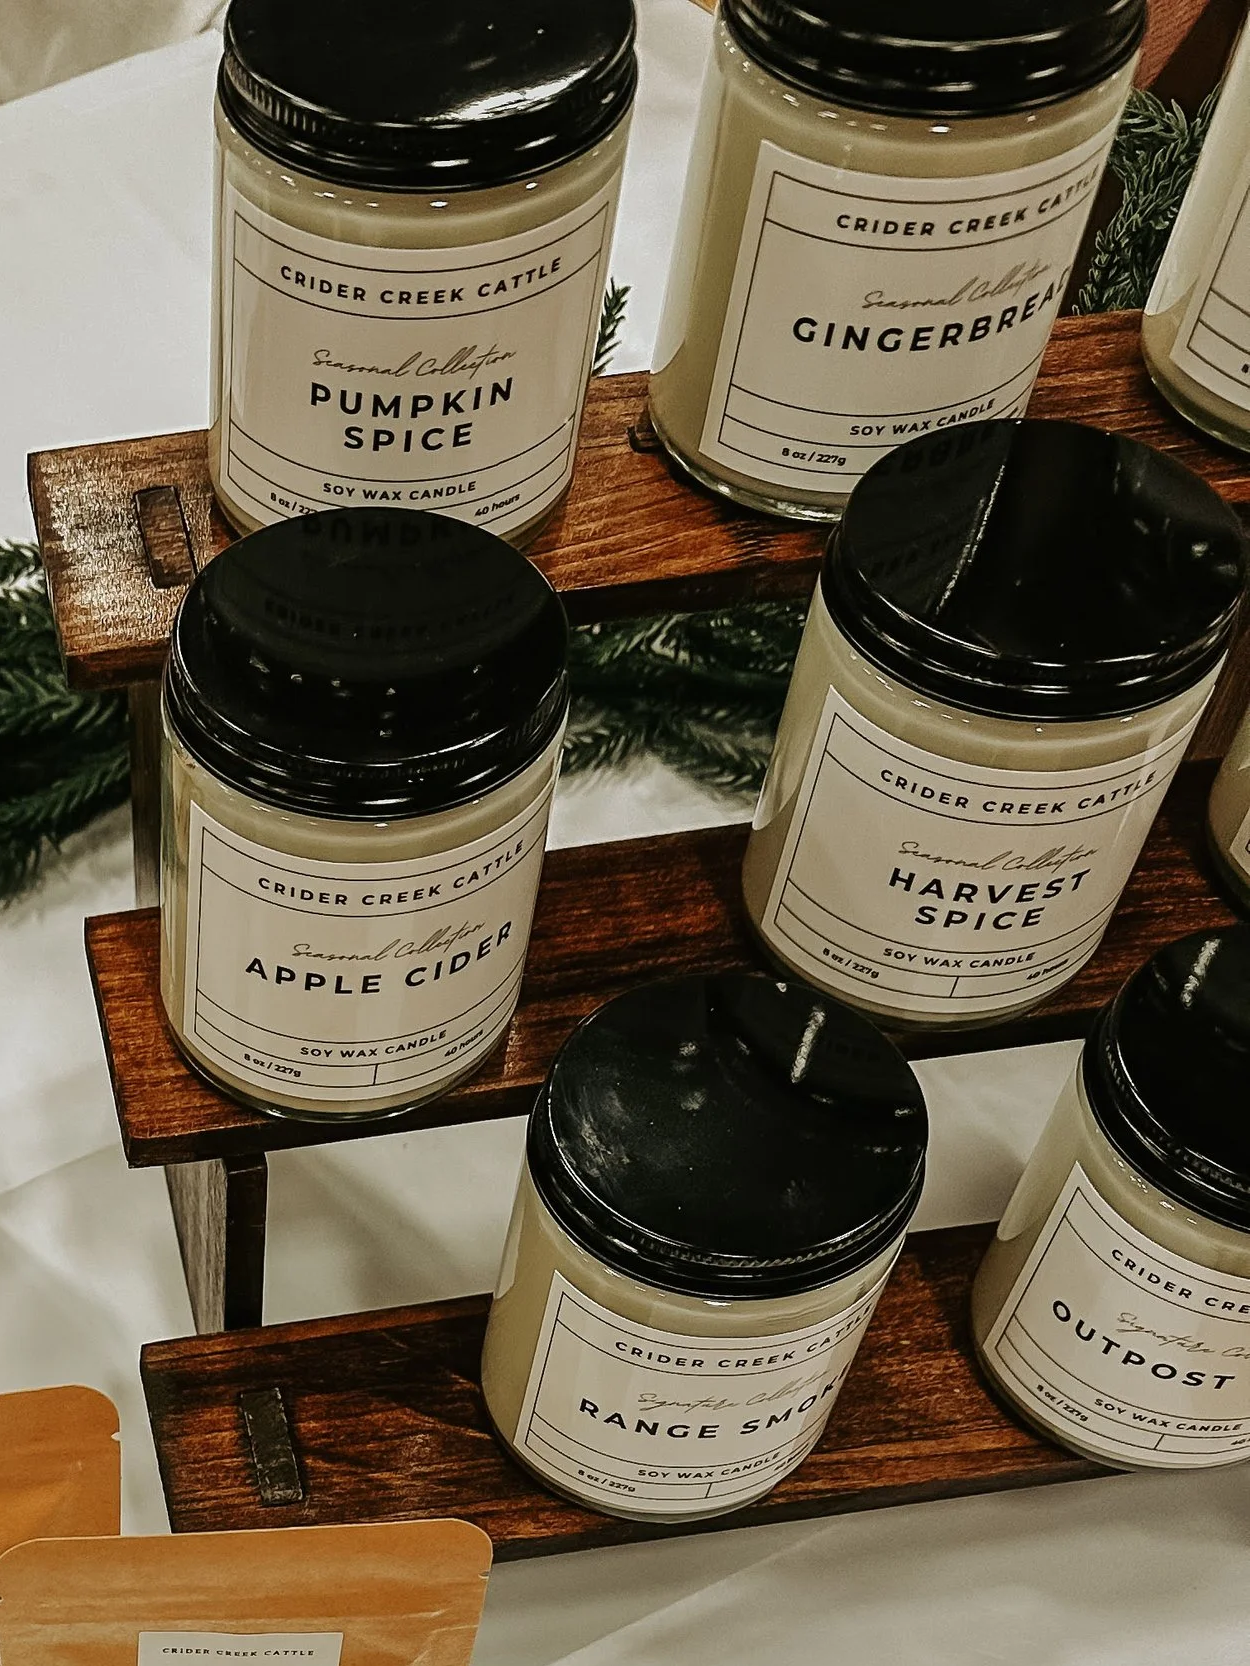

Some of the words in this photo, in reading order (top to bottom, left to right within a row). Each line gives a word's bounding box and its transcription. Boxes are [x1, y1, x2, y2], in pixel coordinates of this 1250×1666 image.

[836, 214, 934, 236] CRIDER
[949, 208, 1025, 235] CREEK
[280, 265, 366, 301] CRIDER
[380, 287, 464, 304] CREEK
[478, 257, 562, 297] CATTLE
[313, 349, 411, 377] Seasonal
[416, 343, 517, 378] Collection
[311, 377, 513, 418] PUMPKIN
[850, 425, 885, 436] SOY
[893, 420, 931, 435] WAX
[936, 398, 996, 430] CANDLE
[344, 423, 473, 452] SPICE
[782, 447, 789, 456] 8
[791, 451, 806, 460] oz
[816, 453, 846, 467] 227g
[323, 482, 355, 497] SOY
[363, 486, 402, 501] WAX
[409, 481, 477, 501] CANDLE
[475, 506, 489, 516] 40
[491, 493, 520, 511] hours
[880, 769, 969, 809] CRIDER
[982, 800, 1067, 815] CREEK
[1077, 770, 1157, 810] CATTLE
[258, 878, 348, 905] CRIDER
[361, 885, 442, 905] CREEK
[453, 839, 524, 889] CATTLE
[888, 868, 1091, 904] HARVEST
[914, 906, 1045, 930] SPICE
[245, 957, 381, 995] APPLE
[404, 920, 512, 987] CIDER
[883, 948, 917, 963] SOY
[923, 955, 963, 969] WAX
[969, 952, 1035, 969] CANDLE
[300, 1046, 332, 1057] SOY
[340, 1048, 378, 1057] WAX
[385, 1030, 446, 1055] CANDLE
[1112, 1249, 1192, 1298] CRIDER
[615, 1341, 704, 1368] CRIDER
[718, 1350, 795, 1368] CREEK
[1053, 1301, 1235, 1390] OUTPOST
[579, 1398, 720, 1439] RANGE
[1095, 1398, 1126, 1416] SOY
[1133, 1412, 1170, 1428] WAX
[1176, 1423, 1243, 1432] CANDLE
[638, 1469, 670, 1478] SOY
[677, 1471, 715, 1479] WAX
[721, 1452, 779, 1476] CANDLE
